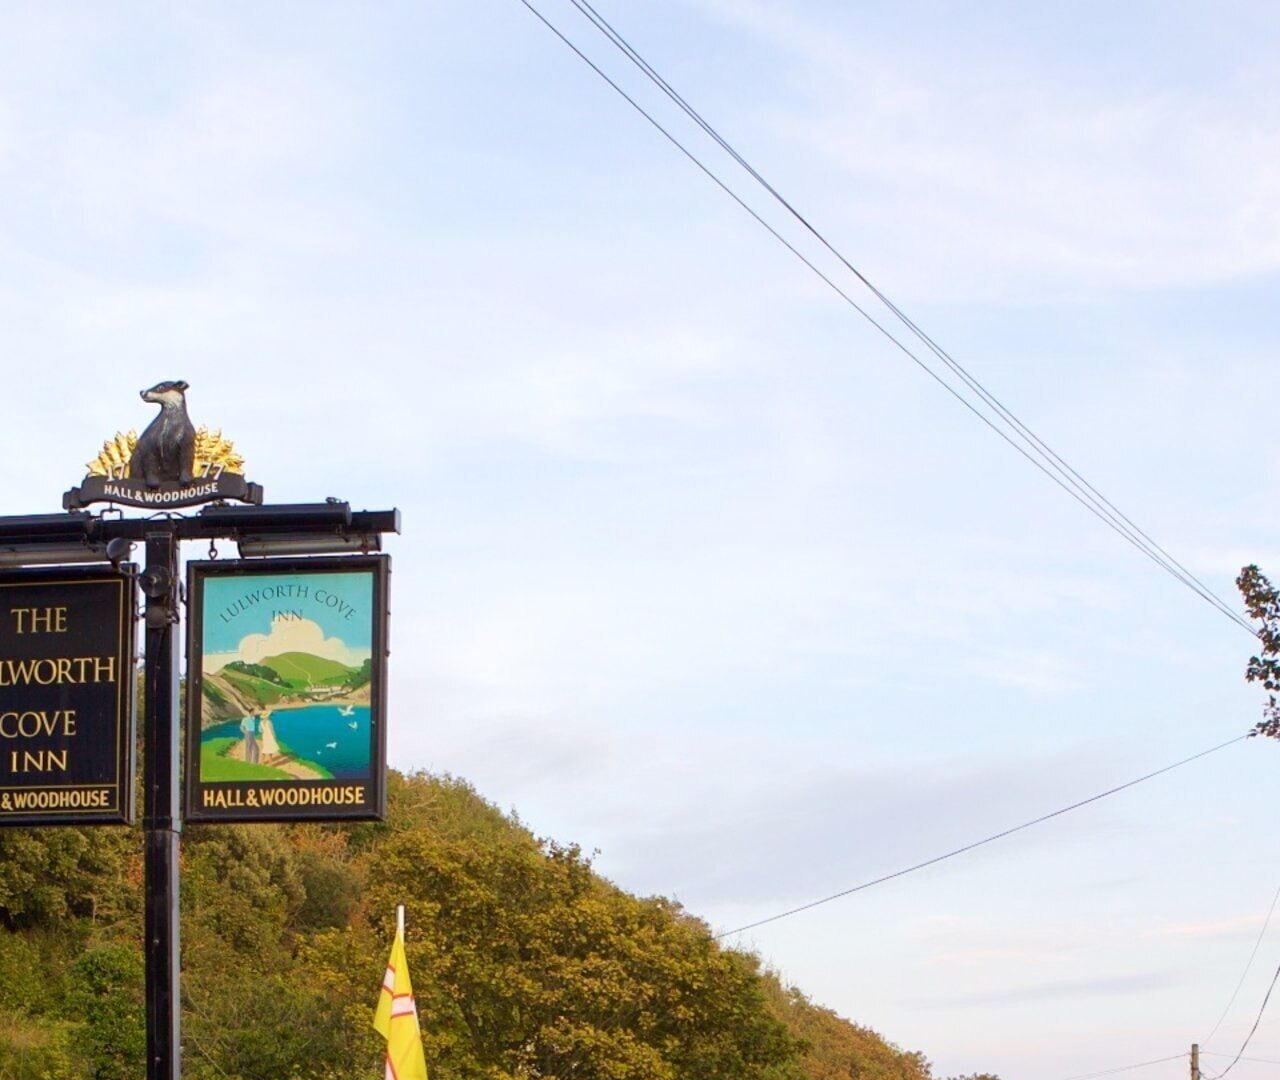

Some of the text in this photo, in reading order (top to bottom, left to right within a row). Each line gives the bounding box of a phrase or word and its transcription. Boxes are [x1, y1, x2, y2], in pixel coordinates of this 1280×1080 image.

[219, 584, 357, 624] LULWORTH COVE
[272, 609, 303, 622] INN
[10, 606, 68, 634] THE
[10, 750, 68, 773] INN
